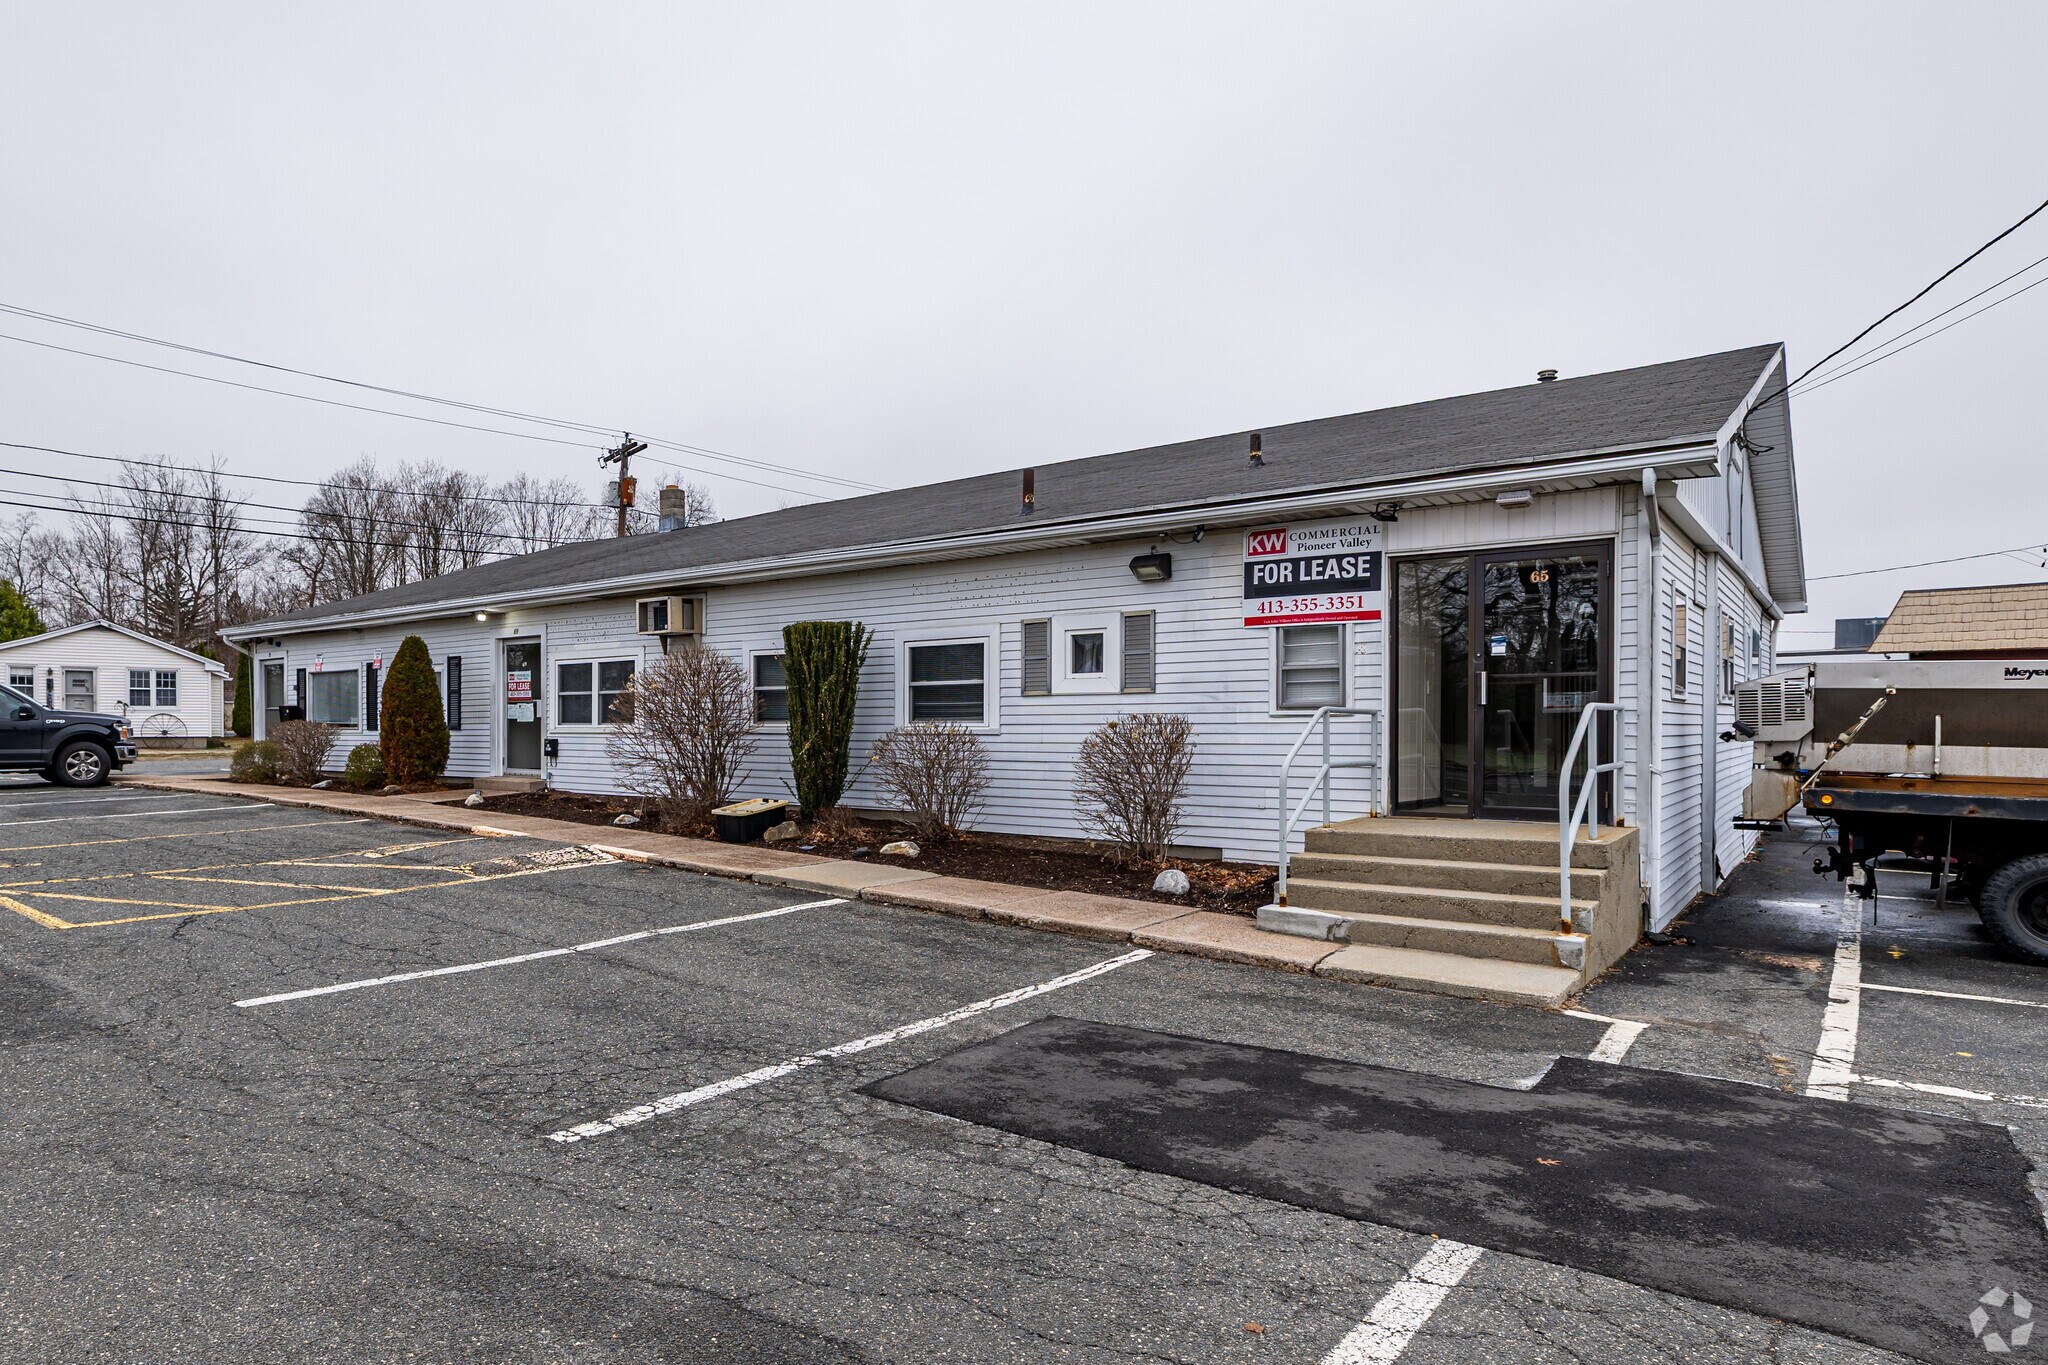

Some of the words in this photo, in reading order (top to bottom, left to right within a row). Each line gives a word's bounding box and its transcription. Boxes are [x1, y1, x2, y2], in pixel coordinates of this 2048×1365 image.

[1289, 525, 1381, 542] COMMERCIAL
[1249, 532, 1286, 553] KW
[1297, 541, 1337, 552] Pioneer
[1340, 538, 1373, 549] Valley
[1253, 562, 1293, 585] FOR
[1300, 556, 1371, 581] LEASE
[1530, 570, 1549, 583] 65
[1257, 595, 1364, 614] 413-355-3351
[508, 682, 517, 690] FOR
[517, 682, 530, 690] LEASE
